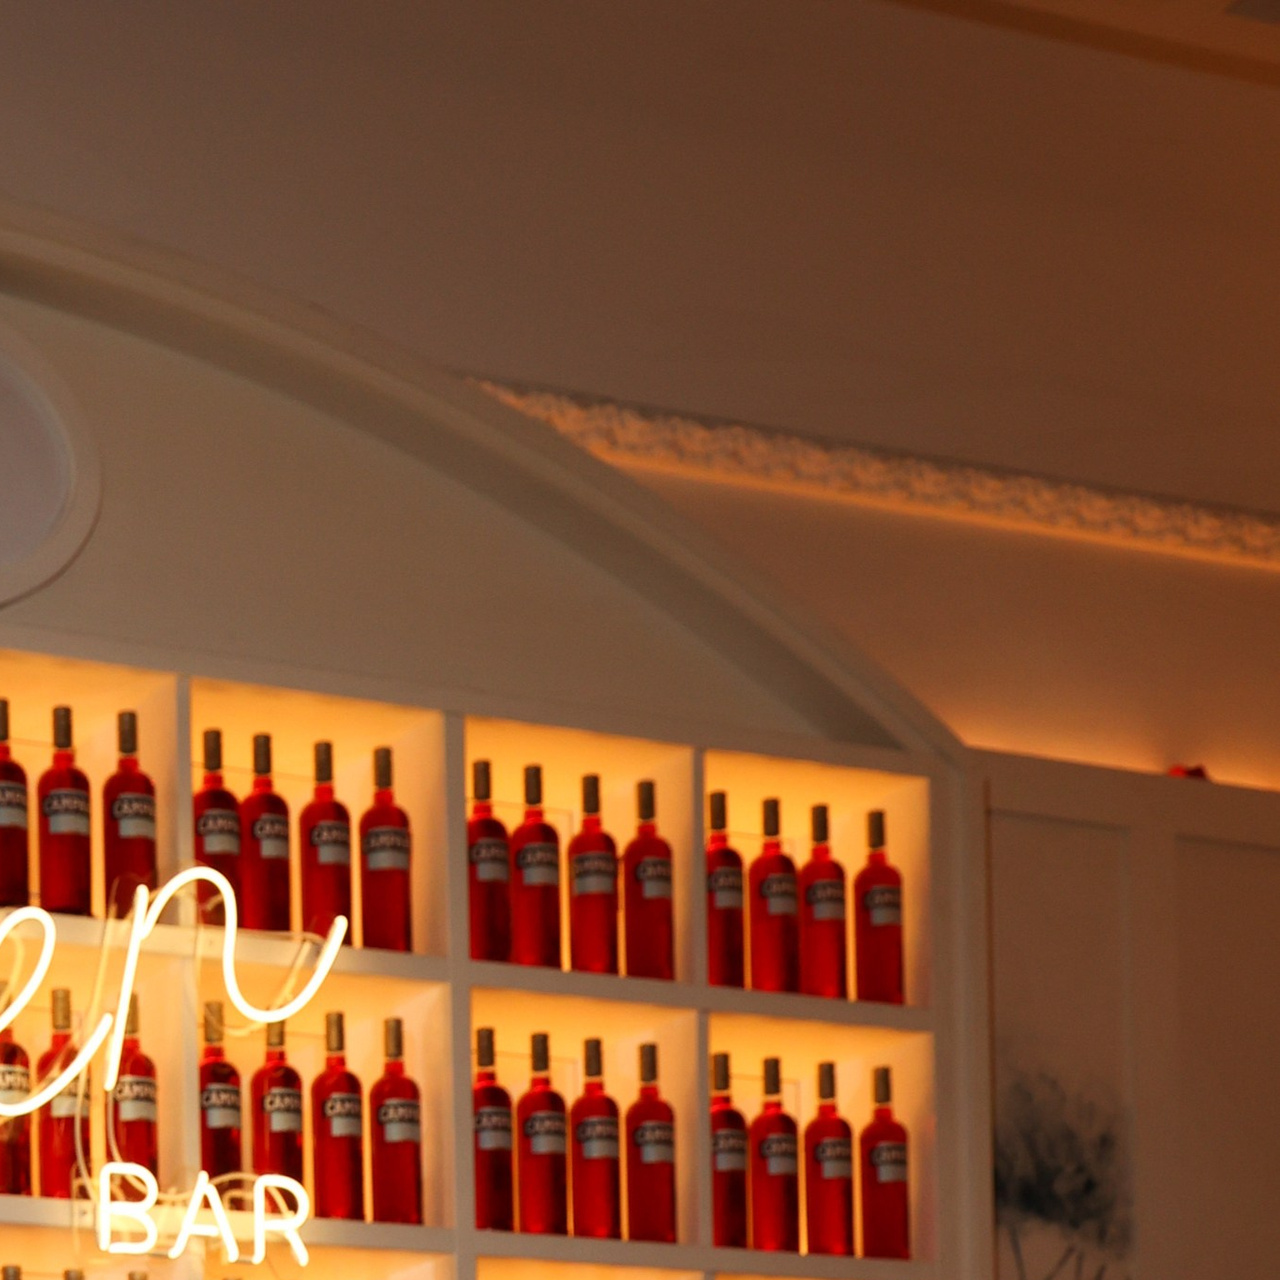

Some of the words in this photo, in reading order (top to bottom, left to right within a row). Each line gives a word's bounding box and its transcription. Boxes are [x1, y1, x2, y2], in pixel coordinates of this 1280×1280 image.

[44, 795, 89, 814] CAMPA
[113, 799, 155, 817] CAMPA
[117, 1081, 156, 1099] CAMPA
[203, 1088, 239, 1108] CAMP
[265, 1093, 301, 1111] CAMP
[326, 1098, 361, 1116] CAMP
[381, 1105, 419, 1122] CAMPA
[99, 1162, 309, 1267] BAR
